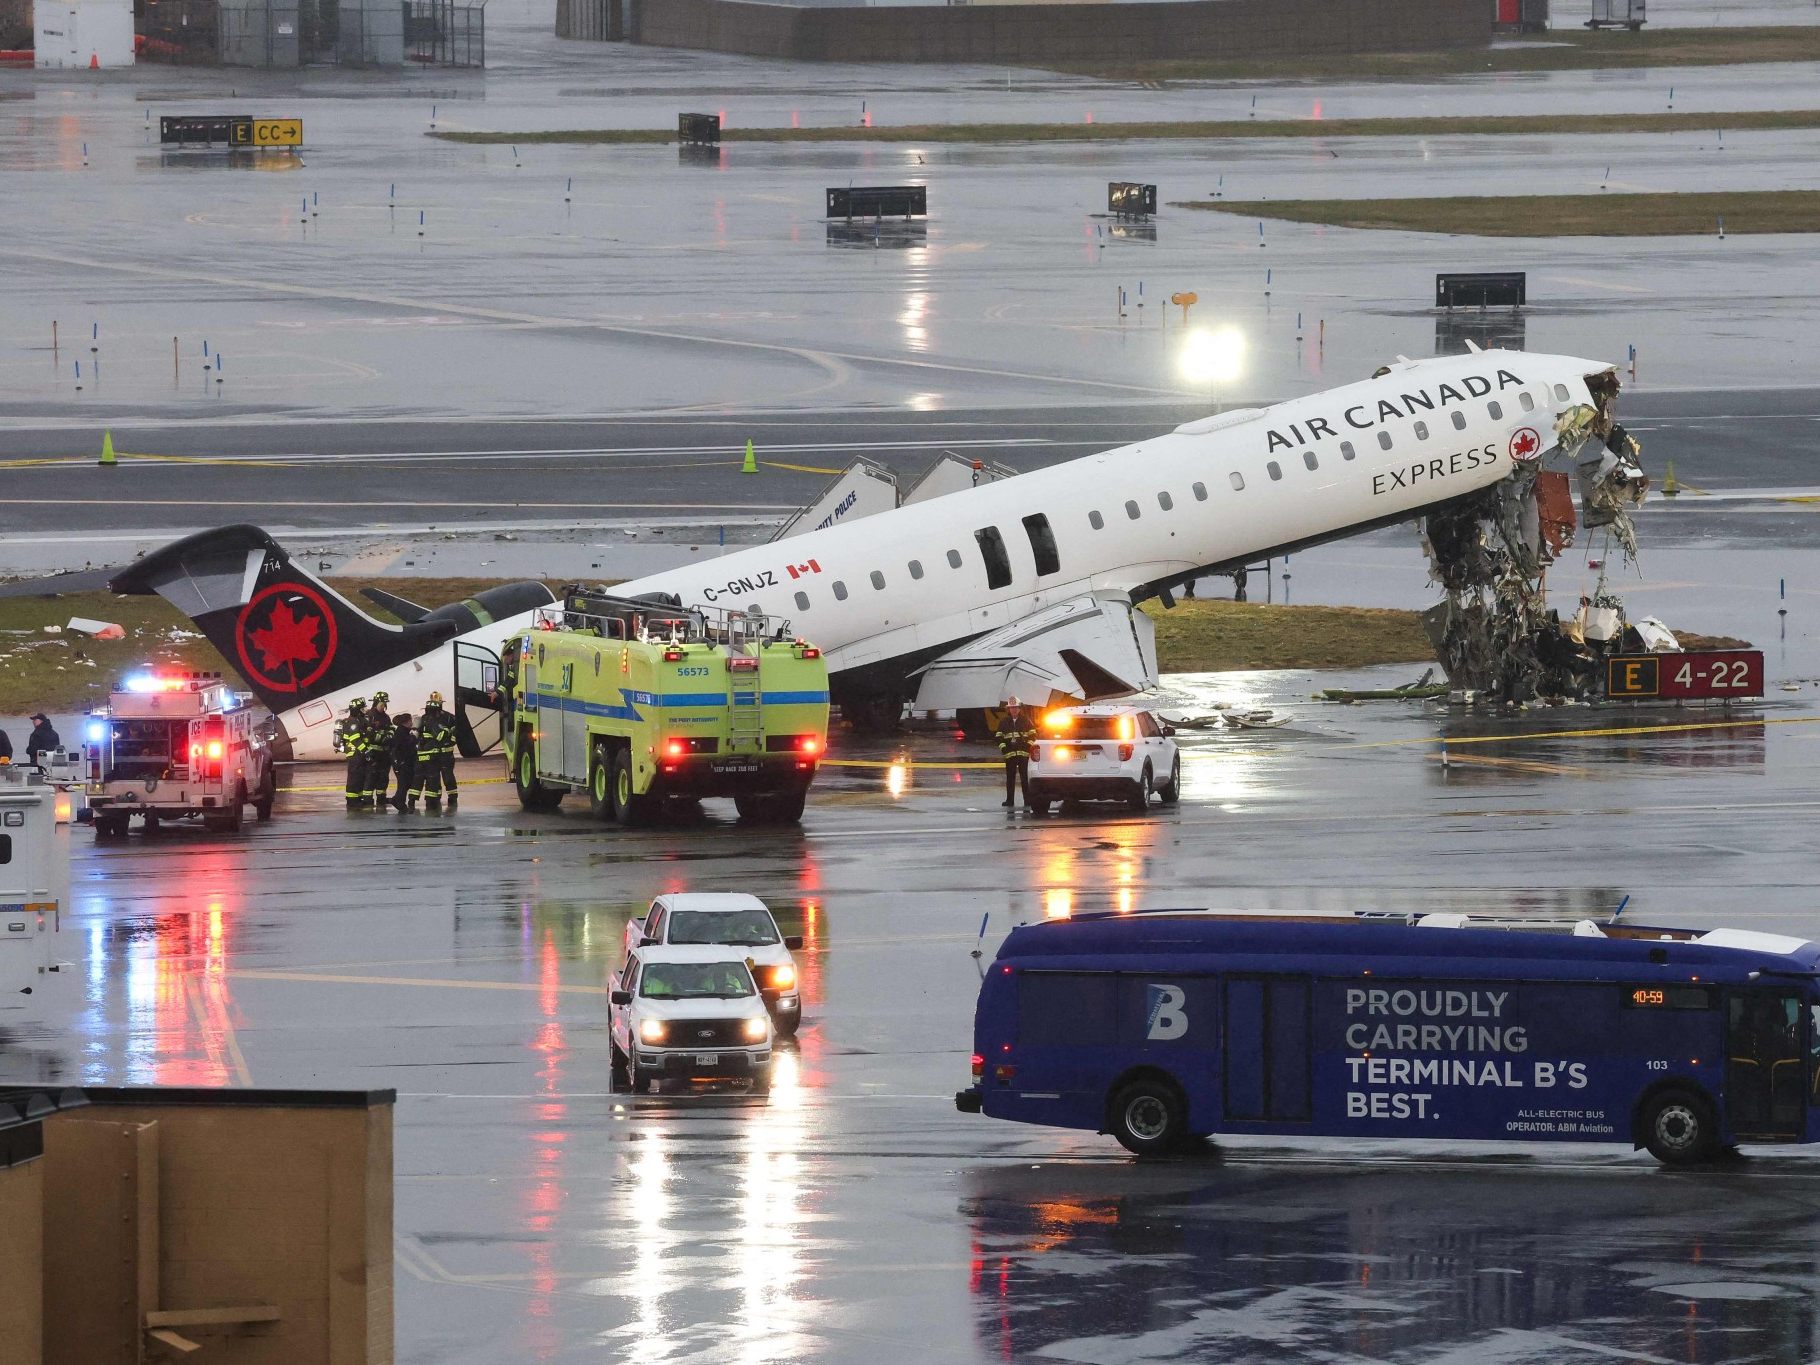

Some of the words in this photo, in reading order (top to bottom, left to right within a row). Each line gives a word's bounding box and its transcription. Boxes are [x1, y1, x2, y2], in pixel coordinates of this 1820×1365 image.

[236, 124, 247, 141] E
[258, 125, 281, 140] CC
[1266, 417, 1338, 453] AIR
[1344, 369, 1525, 429] CANADA
[1372, 444, 1497, 496] EXPRESS
[834, 490, 857, 519] POLICE
[263, 560, 281, 573] 714
[703, 570, 779, 602] C-GNJZ
[677, 667, 710, 677] 56573
[1625, 663, 1642, 690] E
[1674, 660, 1749, 688] 4-22
[1346, 988, 1509, 1017] PROUDLY
[1632, 990, 1663, 1003] 40-59
[1146, 983, 1189, 1040] B
[1345, 1023, 1528, 1053] CARRYING
[1345, 1057, 1523, 1087] TERMINAL
[1534, 1060, 1588, 1089] B'S
[1646, 1060, 1668, 1070] 103
[1346, 1091, 1440, 1120] BEST.
[1517, 1109, 1584, 1119] ALL-ELECTRIC
[1585, 1110, 1605, 1119] BUS
[1506, 1121, 1556, 1132] OPERATOR:
[1557, 1122, 1577, 1132] ABM
[1579, 1123, 1614, 1133] Aviation
